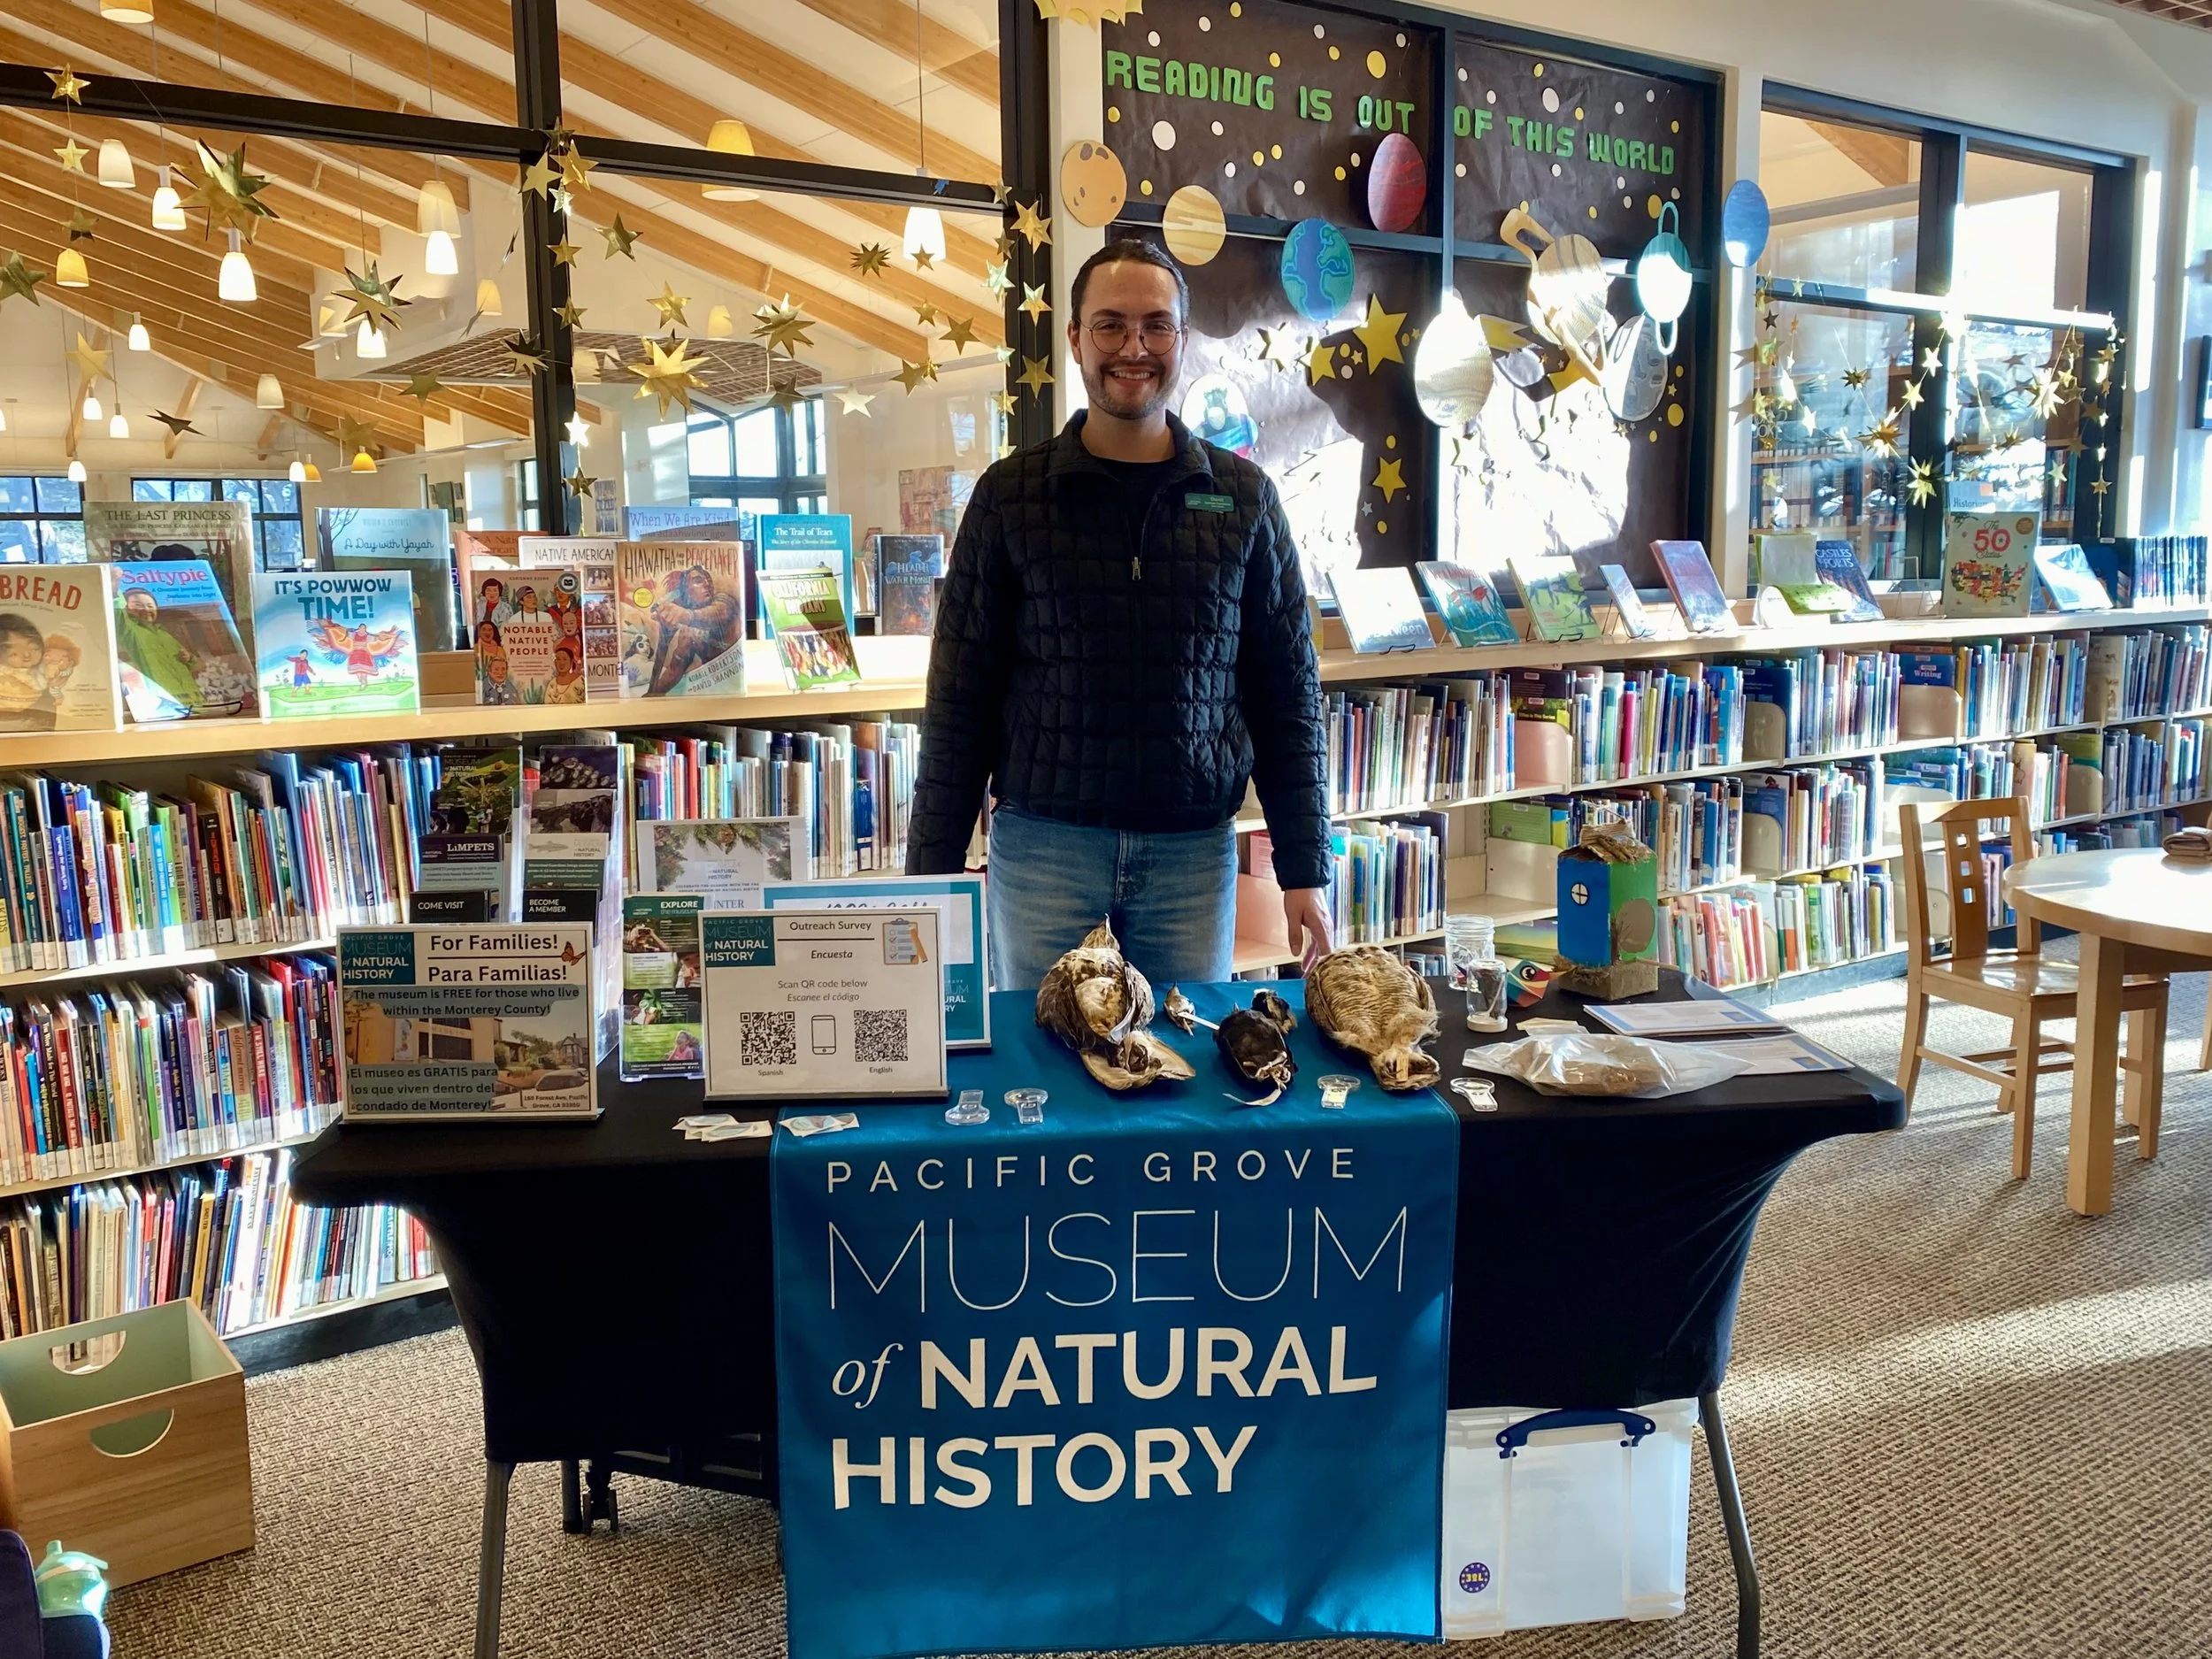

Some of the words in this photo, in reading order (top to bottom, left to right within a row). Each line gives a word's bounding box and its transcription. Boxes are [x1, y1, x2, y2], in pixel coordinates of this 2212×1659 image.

[1107, 50, 1274, 111] READING
[1299, 86, 1332, 121] IS
[1358, 95, 1415, 134] OUT
[1454, 105, 1493, 141] OF
[1505, 115, 1574, 157] THIS
[1588, 132, 1675, 176] WORLD
[106, 510, 132, 521] THE
[137, 510, 168, 521] LAST
[173, 510, 232, 521] PRINCESS
[630, 513, 661, 527] When
[664, 513, 681, 526] We
[684, 513, 701, 526] Are
[705, 513, 730, 527] Kind
[789, 527, 805, 536] Trail
[806, 527, 815, 536] of
[1984, 520, 2000, 530] The
[344, 538, 353, 550] A
[356, 538, 376, 553] Day
[379, 538, 399, 549] with
[401, 538, 435, 553] Yayah
[1974, 529, 2011, 553] 50
[534, 548, 568, 562] NATIVE
[1815, 549, 1852, 558] CASTLES
[624, 547, 676, 583] HIAWATHA
[686, 547, 739, 579] PEACEMAKER
[1824, 558, 1854, 568] FORTS
[122, 568, 210, 586] Saltypie
[885, 576, 909, 585] WATER
[0, 574, 82, 611] BREAD
[275, 580, 303, 595] IT'S
[308, 579, 392, 594] POWWOW
[772, 579, 830, 597] CALIFORNIA
[297, 595, 374, 621] TIME!
[503, 626, 553, 634] NOTABLE
[509, 636, 549, 645] NATIVE
[510, 647, 549, 656] PEOPLE
[707, 646, 743, 673] ROBERTSON
[588, 662, 624, 677] MONTH
[1914, 670, 1942, 679] Writing
[692, 680, 712, 693] DAVID
[713, 663, 744, 685] SHANNON
[447, 843, 495, 852] LiMPETS
[418, 901, 443, 910] COME
[444, 901, 465, 909] VISIT
[660, 900, 699, 909] EXPLORE
[713, 899, 745, 909] INTER
[704, 925, 772, 939] MUSEUM
[789, 921, 835, 931] Outreach
[838, 921, 872, 932] Survey
[342, 942, 411, 956] MUSEUM
[430, 935, 463, 951] For
[469, 933, 558, 950] Families!
[714, 939, 768, 951] NATURAL
[705, 951, 754, 962] HISTORY
[811, 950, 853, 959] Encuesta
[342, 958, 352, 967] of
[352, 957, 409, 967] NATURAL
[342, 969, 395, 979] HISTORY
[428, 966, 473, 982] Para
[479, 965, 568, 982] Familias!
[778, 980, 799, 989] Scan
[801, 980, 815, 990] QR
[818, 979, 839, 988] code
[841, 979, 868, 988] below
[353, 990, 376, 1000] The
[378, 991, 428, 1000] museum
[430, 989, 440, 999] is
[443, 988, 472, 999] FREE
[475, 988, 492, 998] for
[495, 987, 528, 998] those
[530, 987, 555, 998] who
[557, 987, 580, 997] live
[787, 993, 820, 1002] Escanee
[823, 992, 830, 1001] el
[833, 992, 860, 1003] código
[383, 1005, 419, 1016] within
[422, 1005, 442, 1015] the
[444, 1004, 501, 1018] Monterey
[504, 1004, 551, 1017] County!
[42, 1022, 50, 1033] You
[43, 1032, 52, 1047] Were
[252, 1030, 262, 1040] I'M
[45, 1047, 53, 1061] Made
[232, 1034, 246, 1065] different
[254, 1041, 264, 1059] STILL
[48, 1070, 56, 1081] This
[84, 1065, 92, 1079] HOW
[256, 1060, 267, 1077] HERE
[365, 1068, 404, 1078] museo
[407, 1069, 421, 1078] es
[423, 1068, 469, 1078] GRATIS
[471, 1068, 498, 1079] para
[757, 1068, 783, 1078] Spanish
[869, 1066, 893, 1075] English
[236, 1066, 246, 1091] mirror
[50, 1082, 58, 1097] World
[350, 1084, 368, 1094] los
[371, 1085, 394, 1097] que
[397, 1083, 430, 1094] viven
[432, 1083, 473, 1094] dentro
[476, 1083, 495, 1093] del
[356, 1101, 408, 1111] condado
[411, 1100, 427, 1110] de
[429, 1099, 492, 1113] Monterey!
[827, 1154, 1096, 1194] PACIFIC
[1144, 1148, 1355, 1183] GROVE
[828, 1206, 1407, 1313] MUSEUM
[832, 1342, 904, 1409] of
[920, 1325, 1378, 1410] NATURAL
[832, 1425, 1258, 1510] HISTORY
